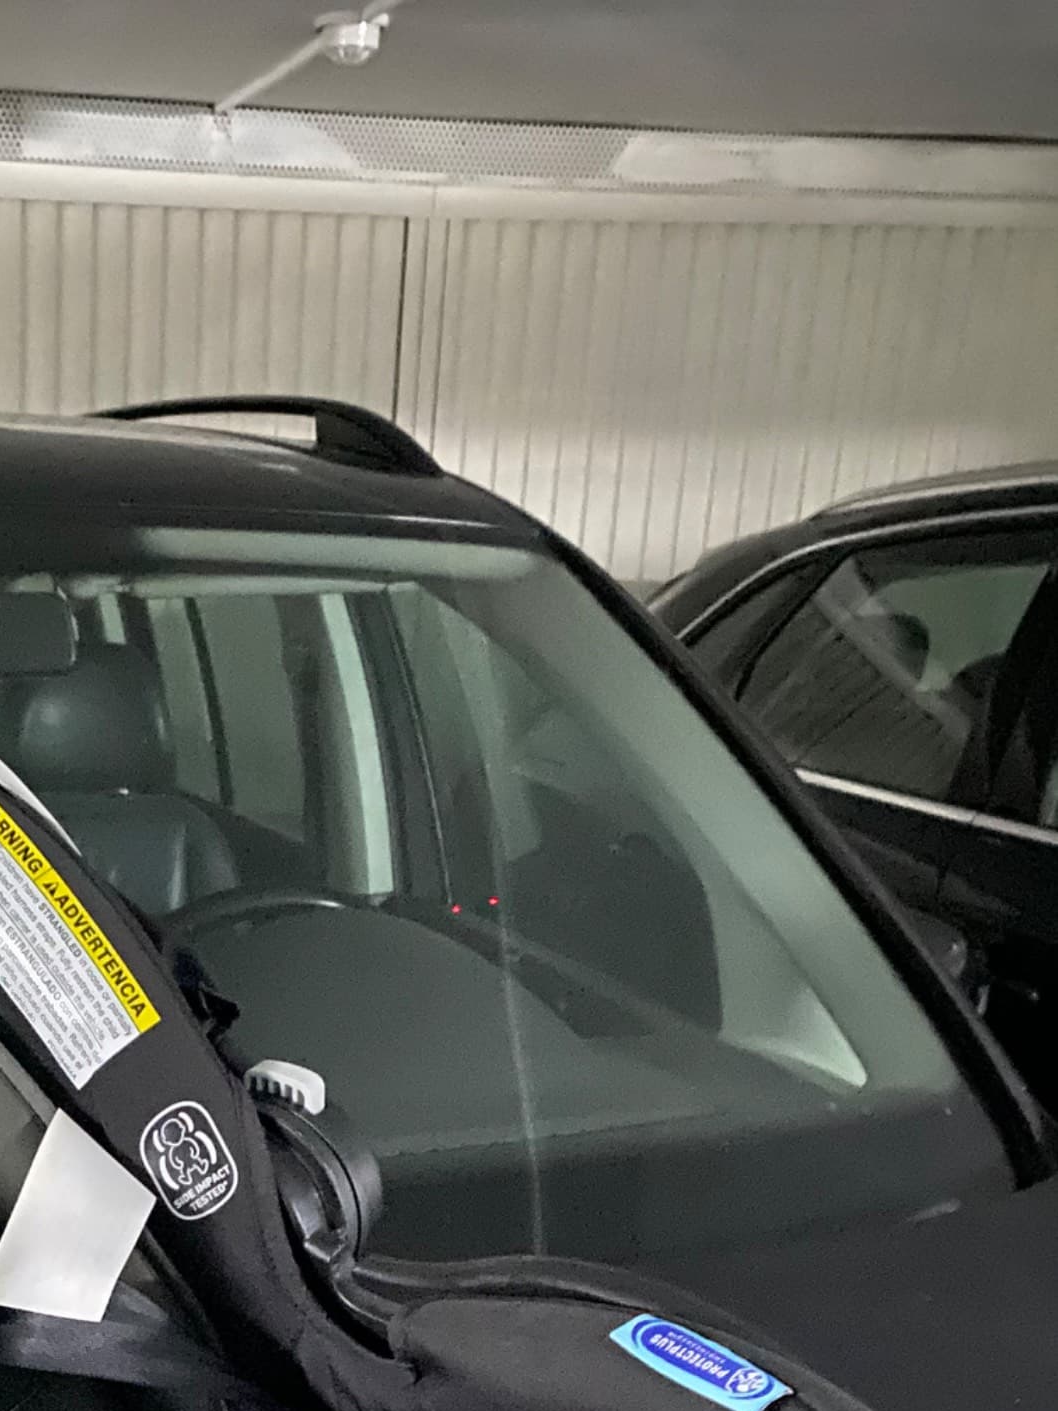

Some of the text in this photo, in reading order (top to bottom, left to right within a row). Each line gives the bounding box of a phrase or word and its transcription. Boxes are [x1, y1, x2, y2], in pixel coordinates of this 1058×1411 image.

[37, 901, 83, 959] STRANGLED
[53, 891, 149, 1018] ADVERTENCIA
[3, 925, 63, 1002] ESTRANGULADO
[172, 1163, 232, 1209] SIDE IMPACT
[648, 1329, 730, 1381] PROTECTPLUS
